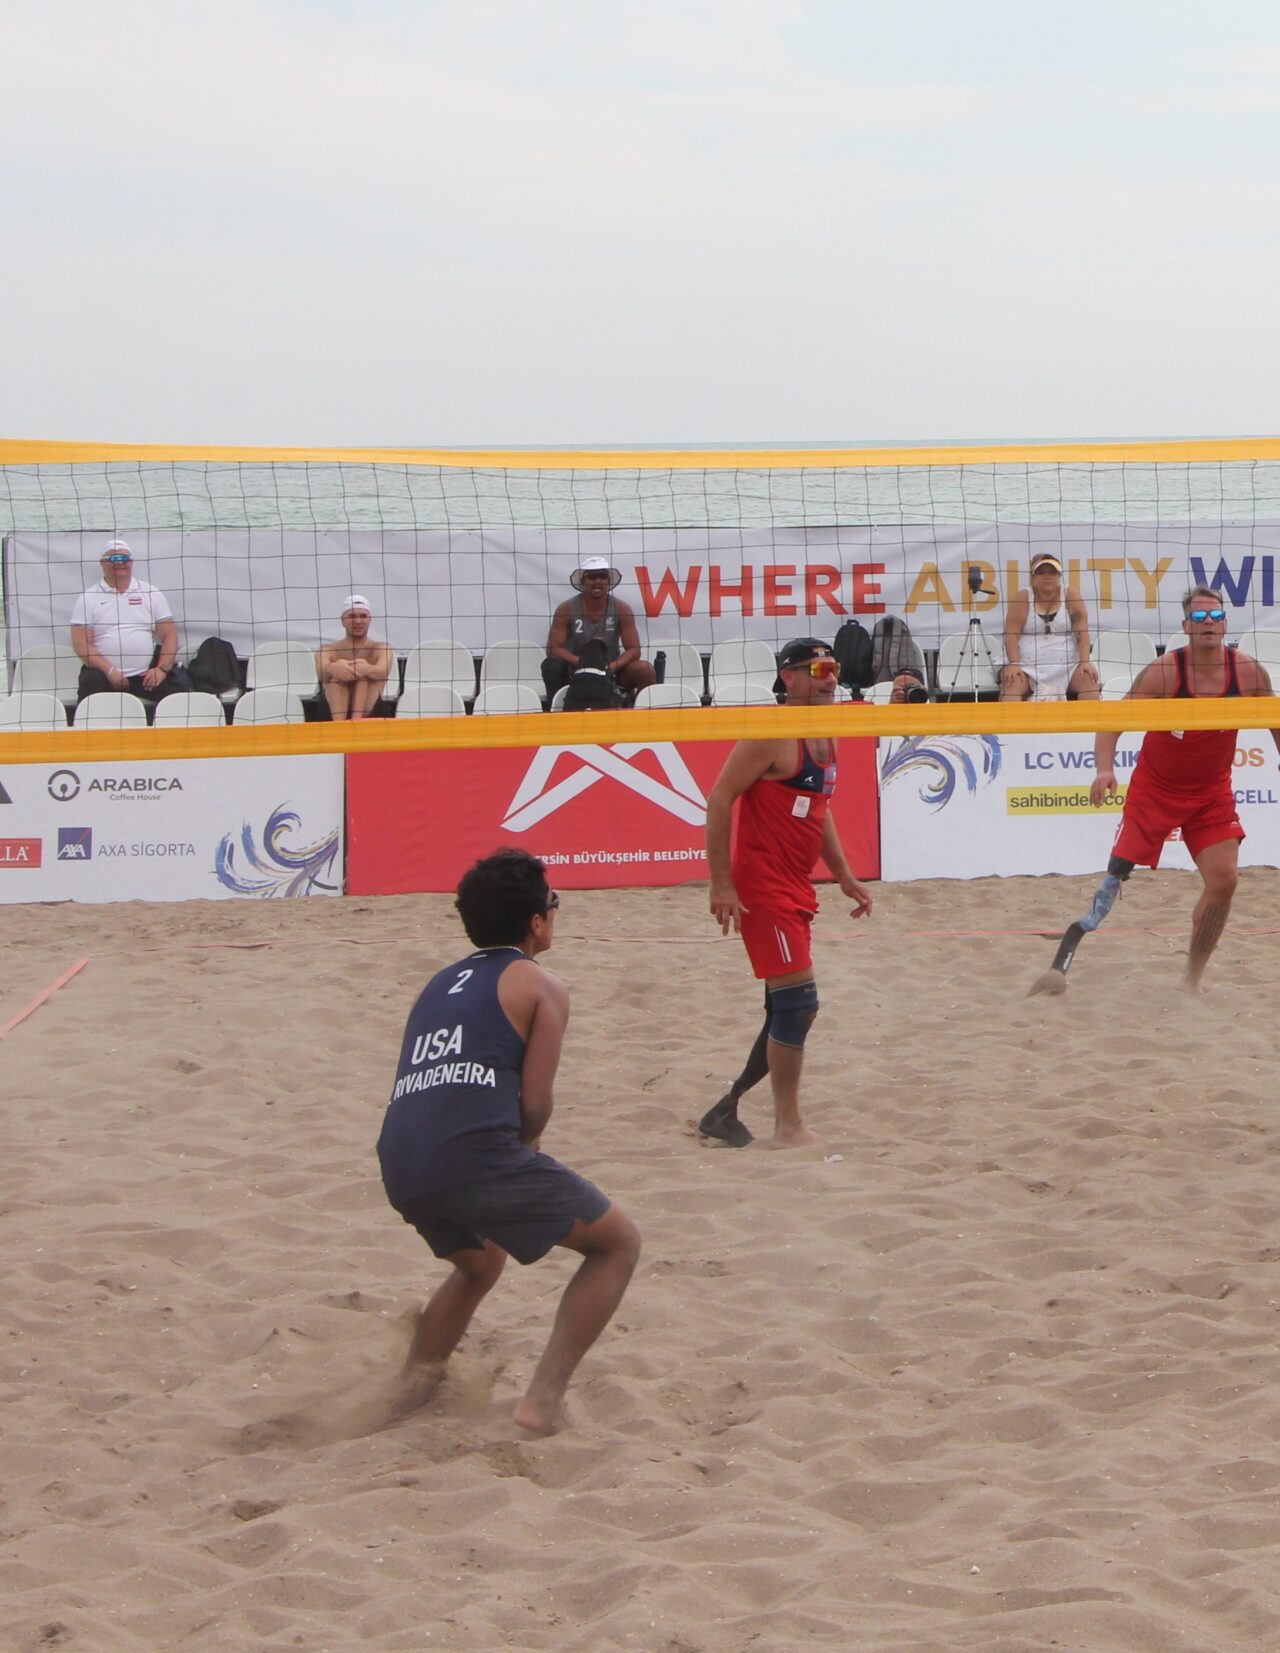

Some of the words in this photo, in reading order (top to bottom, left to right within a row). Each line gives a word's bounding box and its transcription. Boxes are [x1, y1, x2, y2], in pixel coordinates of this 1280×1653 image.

[635, 563, 885, 618] WHERE
[904, 557, 1174, 613] ABIITY
[575, 619, 583, 633] 2
[1024, 752, 1054, 770] LC
[88, 778, 183, 792] ARABICA
[110, 793, 135, 801] Coffee
[137, 793, 161, 801] House
[1233, 789, 1278, 804] CELL
[57, 844, 86, 857] AXA
[98, 844, 127, 857] AXA
[131, 841, 196, 857] SİGORTA
[573, 850, 650, 865] BÜYÜKŞEHİR
[653, 848, 708, 861] BELEDİYE
[448, 969, 474, 995] 2
[411, 1025, 463, 1065] USA
[394, 1062, 496, 1100] RIVADENEIRA
